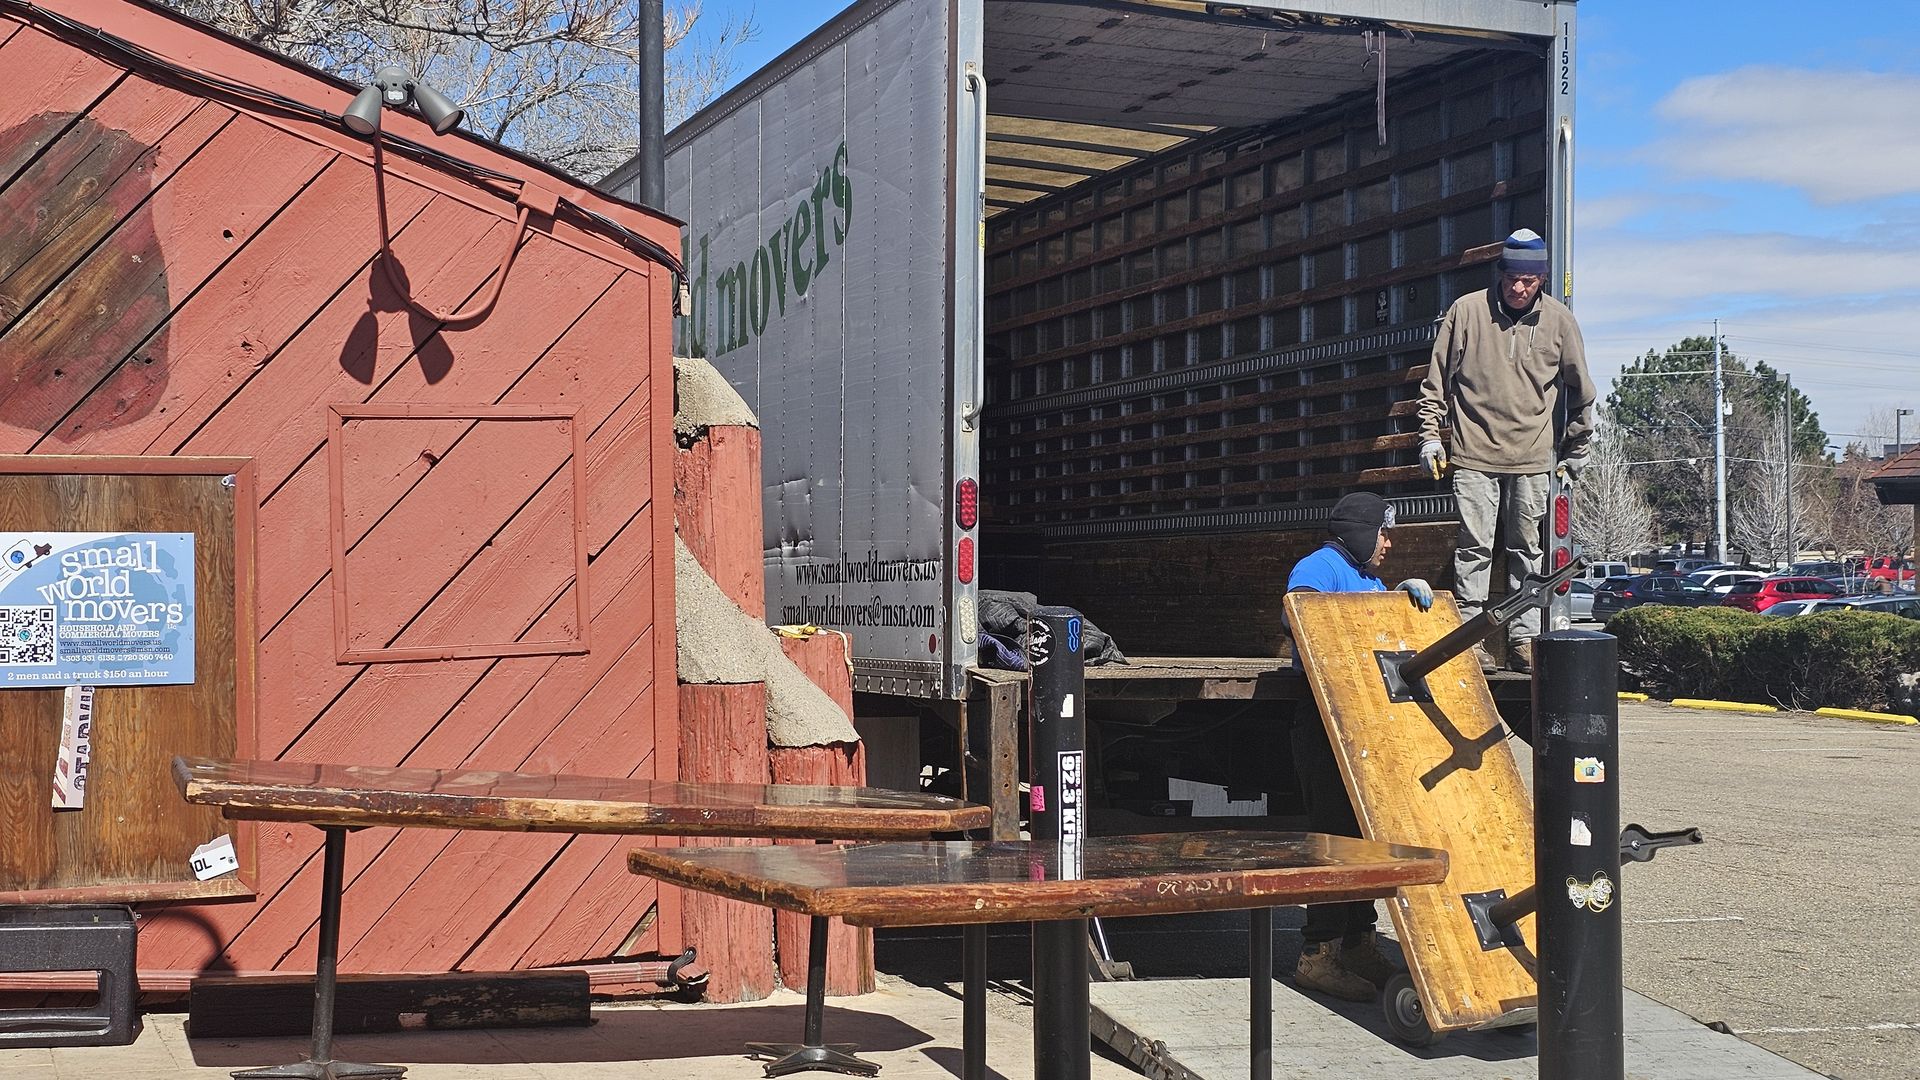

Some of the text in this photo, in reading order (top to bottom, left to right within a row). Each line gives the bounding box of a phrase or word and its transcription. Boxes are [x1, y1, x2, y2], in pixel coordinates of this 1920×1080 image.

[1561, 22, 1569, 95] 11522
[716, 141, 853, 358] movers
[61, 541, 161, 579] small
[796, 550, 937, 585] www.smallworldmovers.us
[36, 569, 134, 605] world
[63, 599, 183, 625] movers
[782, 595, 935, 628] smallworldmovers@msn.com
[59, 625, 115, 633] HOUSEHOLD
[59, 631, 122, 639] COMMERCIAL
[59, 639, 162, 647] www.smallworldmovers.us
[8, 672, 15, 681] 2
[41, 671, 62, 680] and
[72, 670, 101, 679] truck
[103, 669, 127, 679] $150
[144, 669, 169, 678] hour
[1062, 755, 1075, 804] 92.3
